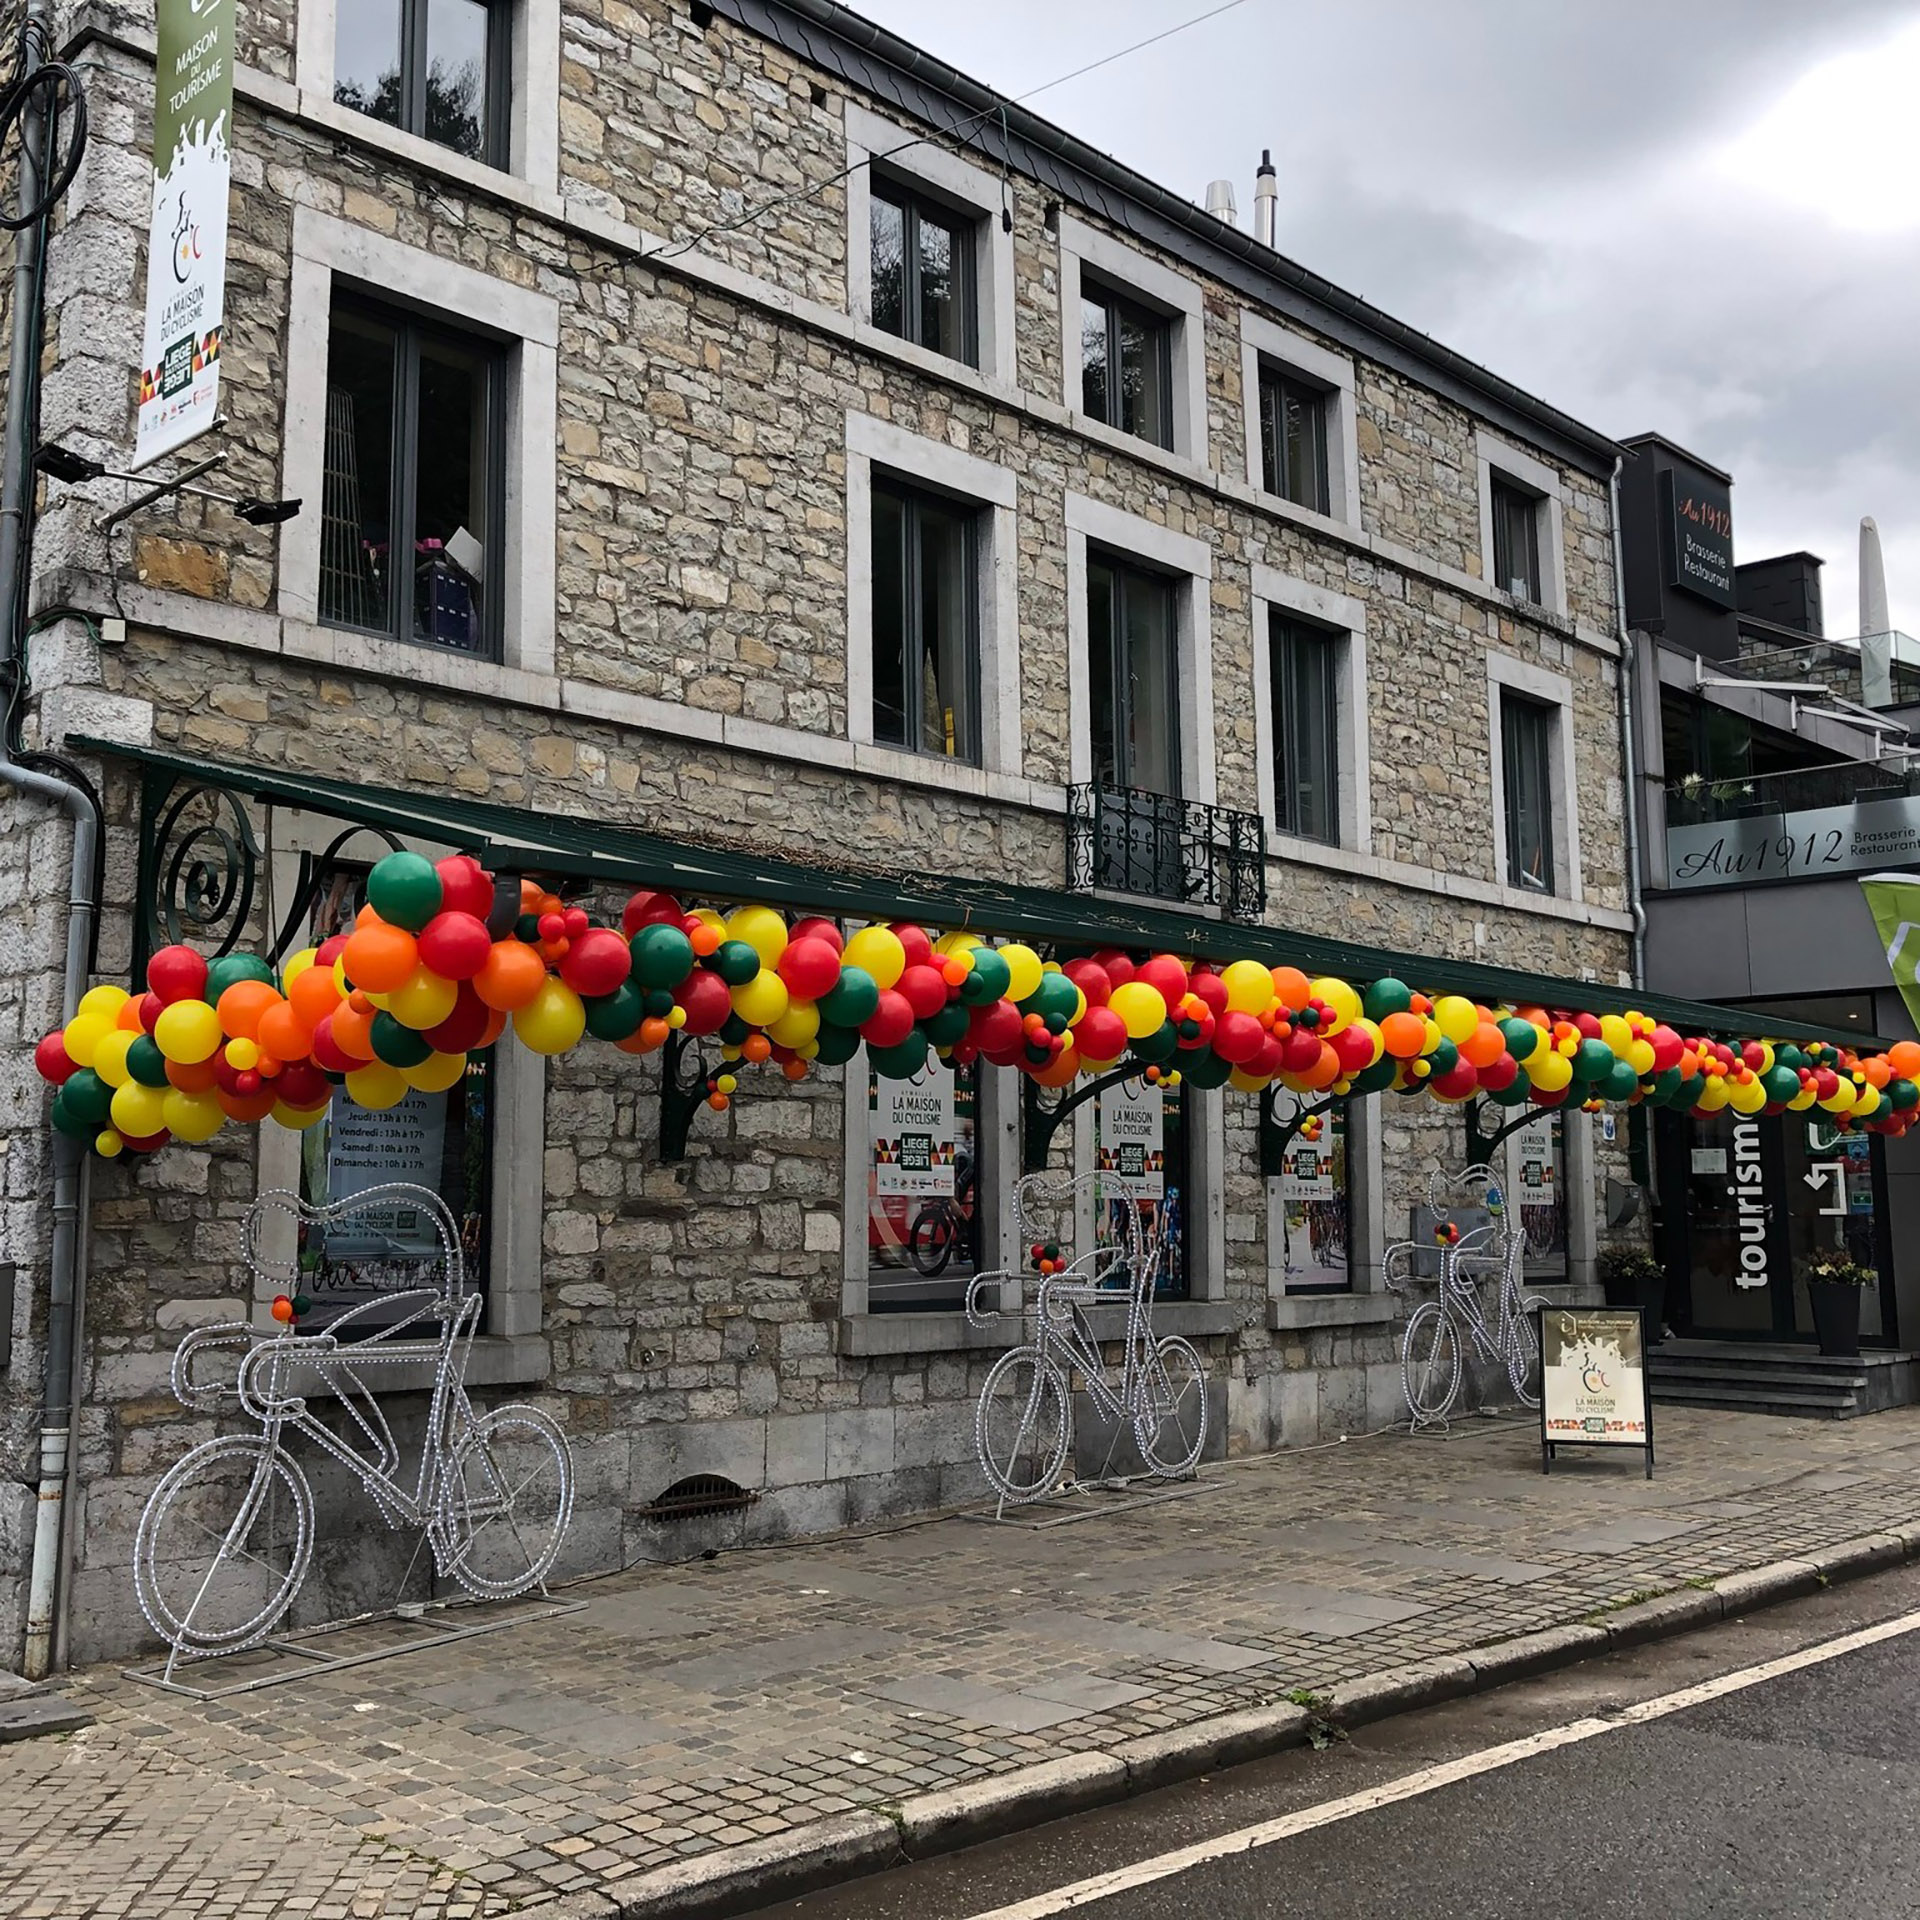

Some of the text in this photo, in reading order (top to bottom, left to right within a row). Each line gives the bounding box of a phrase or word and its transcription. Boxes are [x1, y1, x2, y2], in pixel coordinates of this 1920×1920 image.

[176, 26, 218, 75] MAISON
[191, 62, 201, 78] DU
[169, 58, 222, 114] TOURISME
[162, 306, 171, 324] LA
[174, 284, 204, 314] MAISON
[171, 303, 202, 334] CYCLISME
[166, 340, 192, 370] LIEGE
[1678, 498, 1731, 539] Au 1912
[1686, 534, 1726, 570] Brasserie
[1684, 552, 1730, 592] Restaurant
[1854, 826, 1916, 843] Brasserie
[1676, 830, 1843, 879] Au 1912
[1850, 838, 1920, 857] Restaurant
[412, 1100, 427, 1109] 17h
[893, 1096, 941, 1112] LA MAISON
[893, 1112, 941, 1125] DU CYCLISME
[1113, 1110, 1152, 1123] LA MAISON
[1113, 1124, 1152, 1136] DU CYCLISME
[902, 1138, 928, 1149] LIEGE
[1121, 1147, 1142, 1157] LIEGE
[1727, 1110, 1768, 1289] tourism
